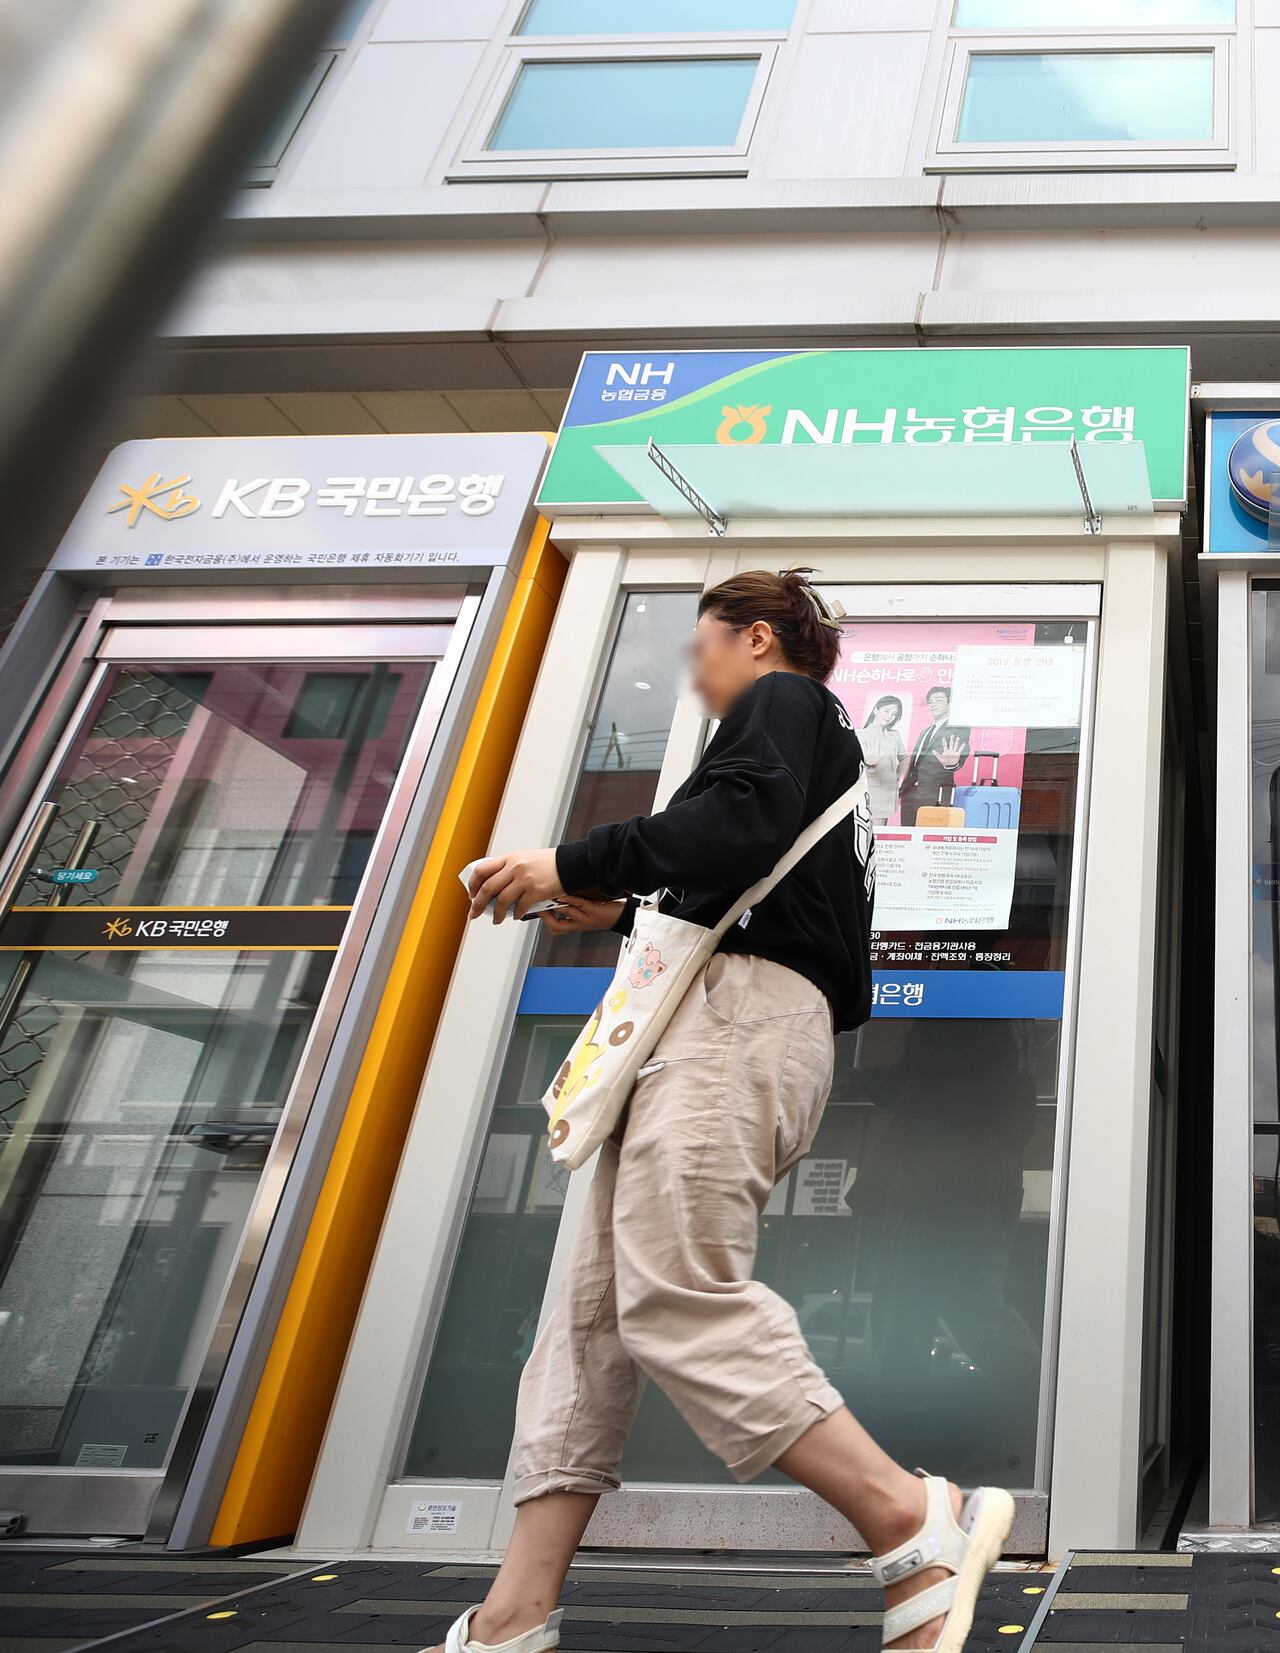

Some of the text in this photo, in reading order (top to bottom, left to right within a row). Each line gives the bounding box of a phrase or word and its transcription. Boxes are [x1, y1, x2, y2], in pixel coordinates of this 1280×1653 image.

[605, 362, 675, 385] NH
[600, 387, 667, 401] 농협금융
[780, 405, 1136, 445] NH농협은행
[96, 552, 460, 565] 본 기기는 한국전자금융(주)에서 운영하는 국민은행 제휴 자동화기기 입니다.
[987, 657, 1010, 666] CCTV
[57, 872, 93, 881] 당기세요
[914, 942, 976, 951] 전금융기관사용
[886, 952, 923, 961] 계좌이체
[930, 952, 967, 961] 잔액조회
[975, 952, 1011, 962] 통장정리
